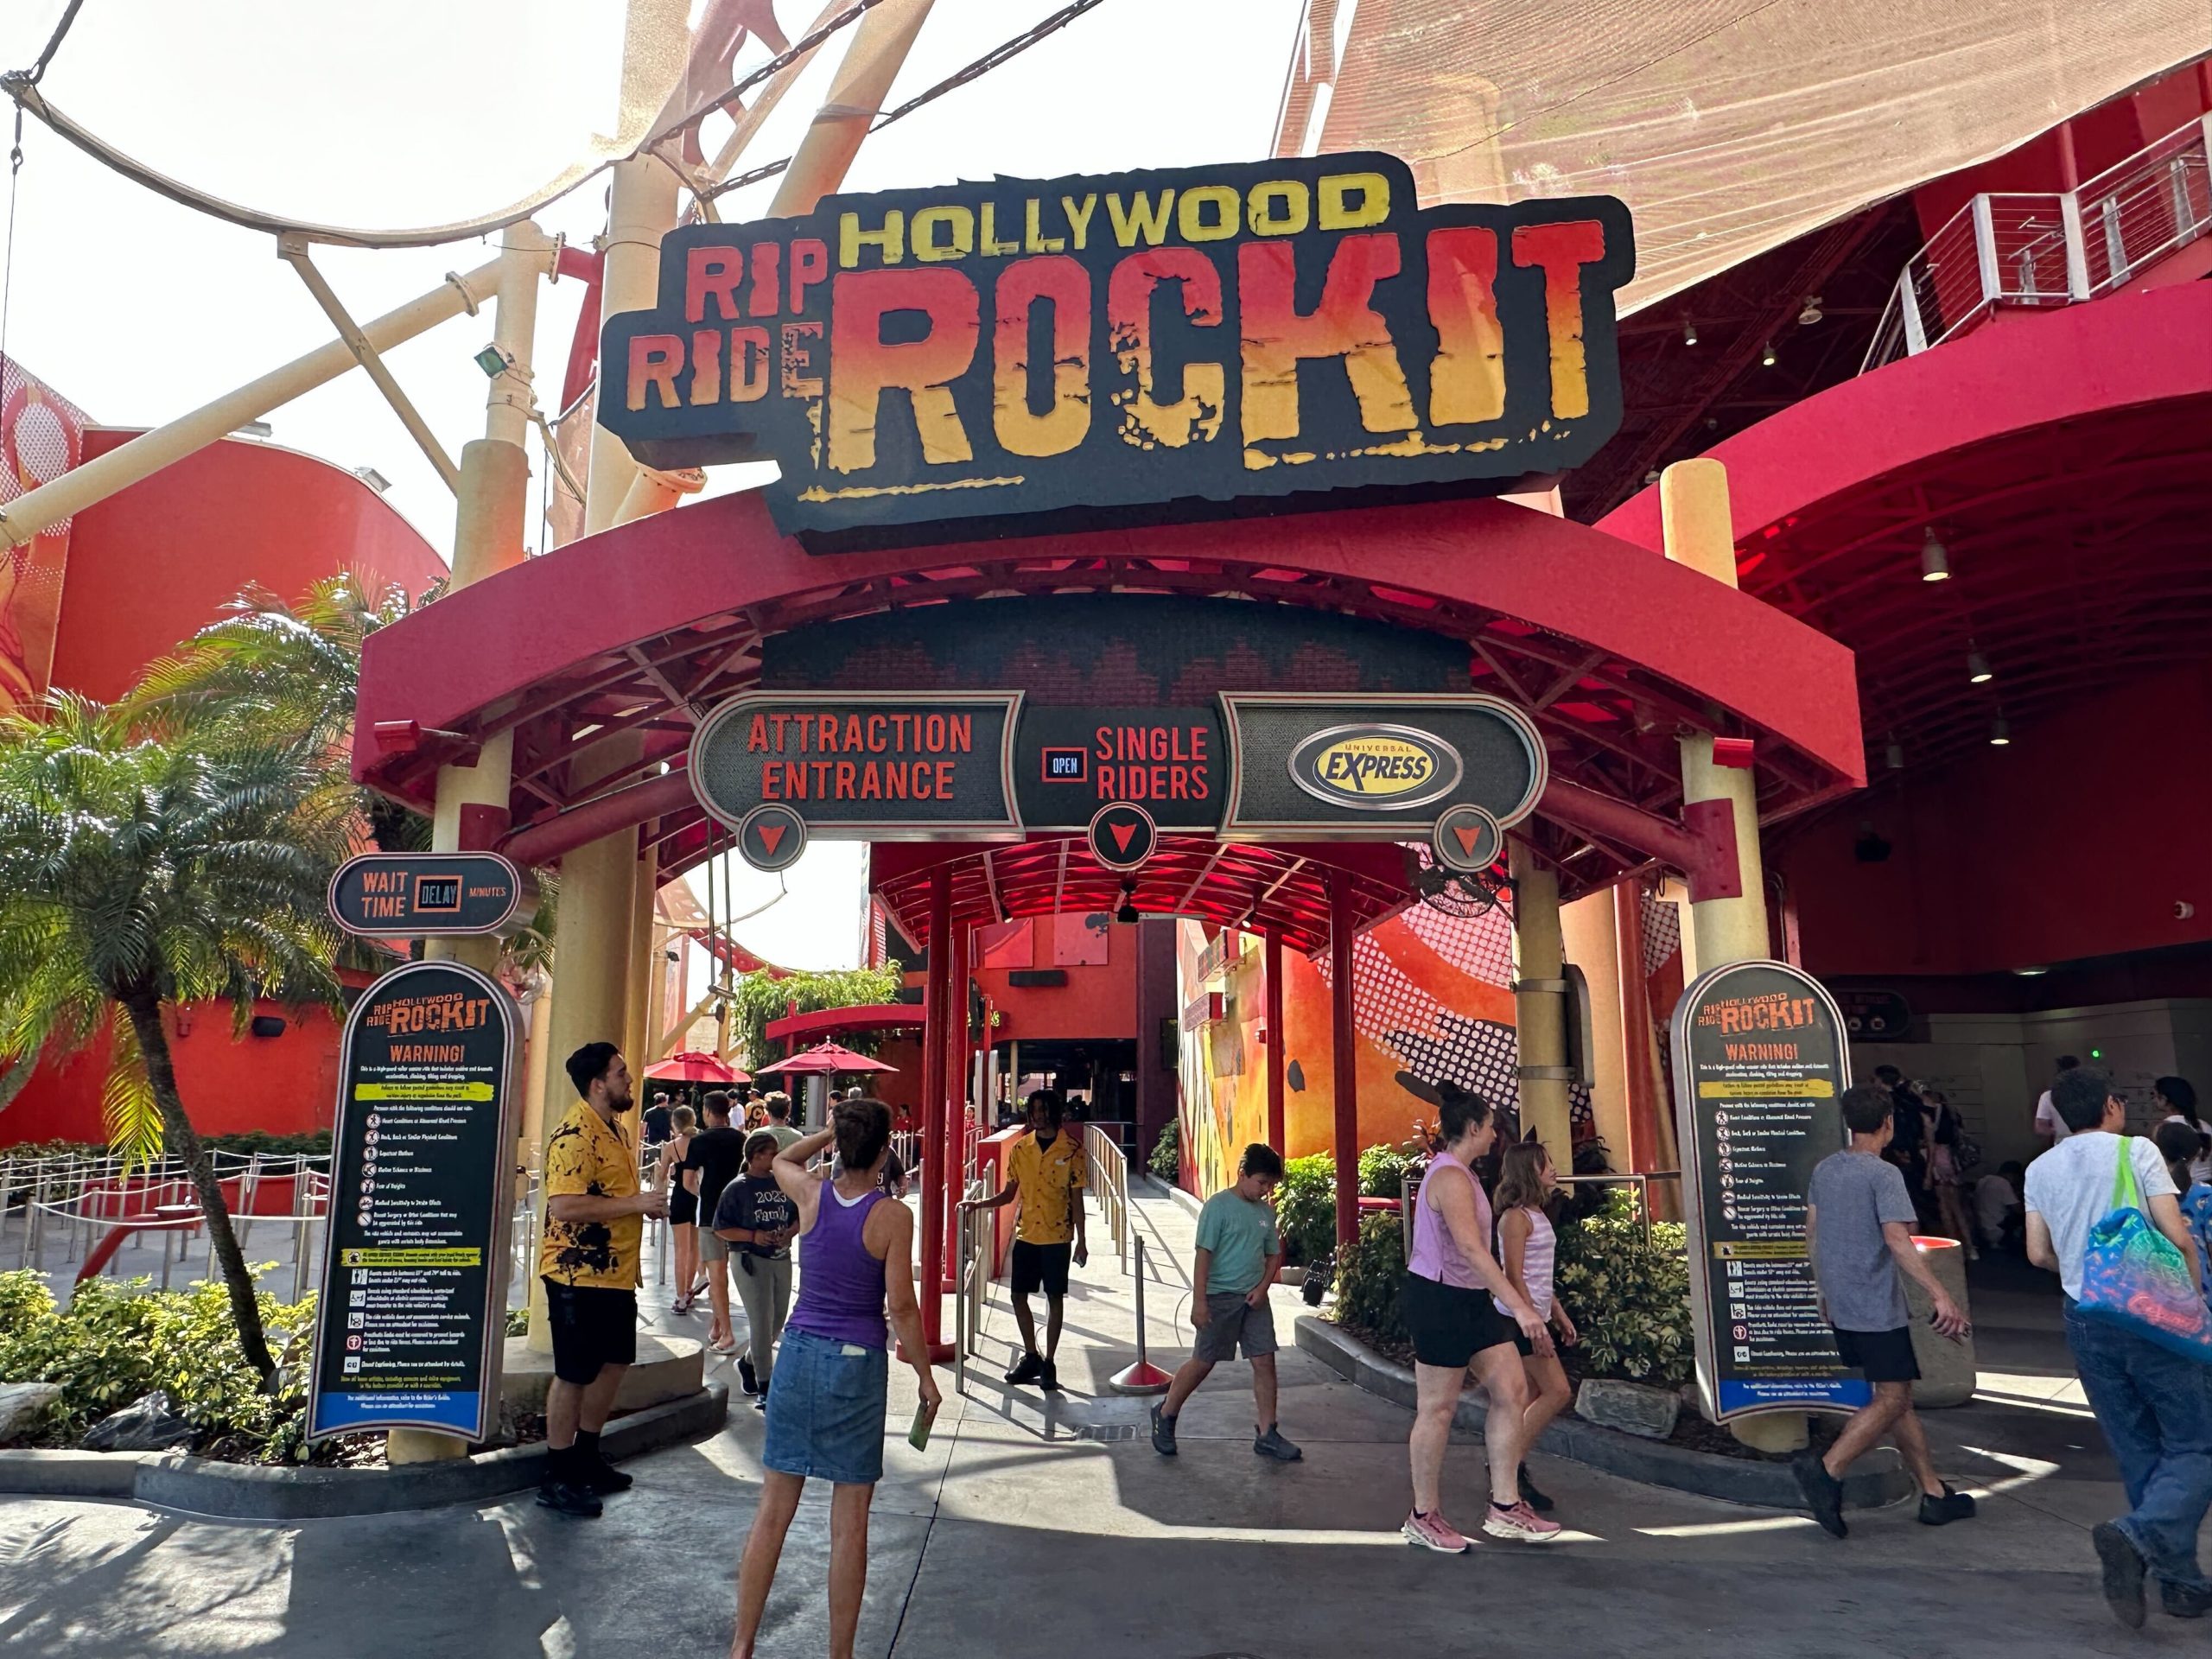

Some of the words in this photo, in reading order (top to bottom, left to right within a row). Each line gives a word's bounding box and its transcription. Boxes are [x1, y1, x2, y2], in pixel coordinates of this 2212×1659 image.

[839, 173, 1390, 268] HOLLYWOOD
[685, 238, 829, 323] RIP
[828, 219, 1605, 476] ROCKIT
[626, 321, 823, 412] RIDE
[747, 714, 971, 753] ATTRACTION
[1095, 727, 1209, 761] SINGLE
[1344, 743, 1413, 753] UNIVERSAL
[1052, 757, 1078, 774] OPEN
[1325, 752, 1428, 791] EXPRESS
[761, 761, 955, 799] ENTRANCE
[1096, 766, 1209, 800] RIDERS
[363, 872, 408, 893] WAIT
[422, 885, 457, 905] DELAY
[469, 887, 506, 898] MINUTES
[361, 897, 406, 918] TIME
[373, 1003, 392, 1015] RIP
[392, 992, 464, 1008] HOLLYWOOD
[390, 999, 491, 1034] ROCKIT
[1720, 998, 1815, 1034] ROCKIT
[390, 1045, 465, 1063] WARNING!
[1726, 1043, 1798, 1061] WARNING!
[754, 1190, 787, 1204] 2023
